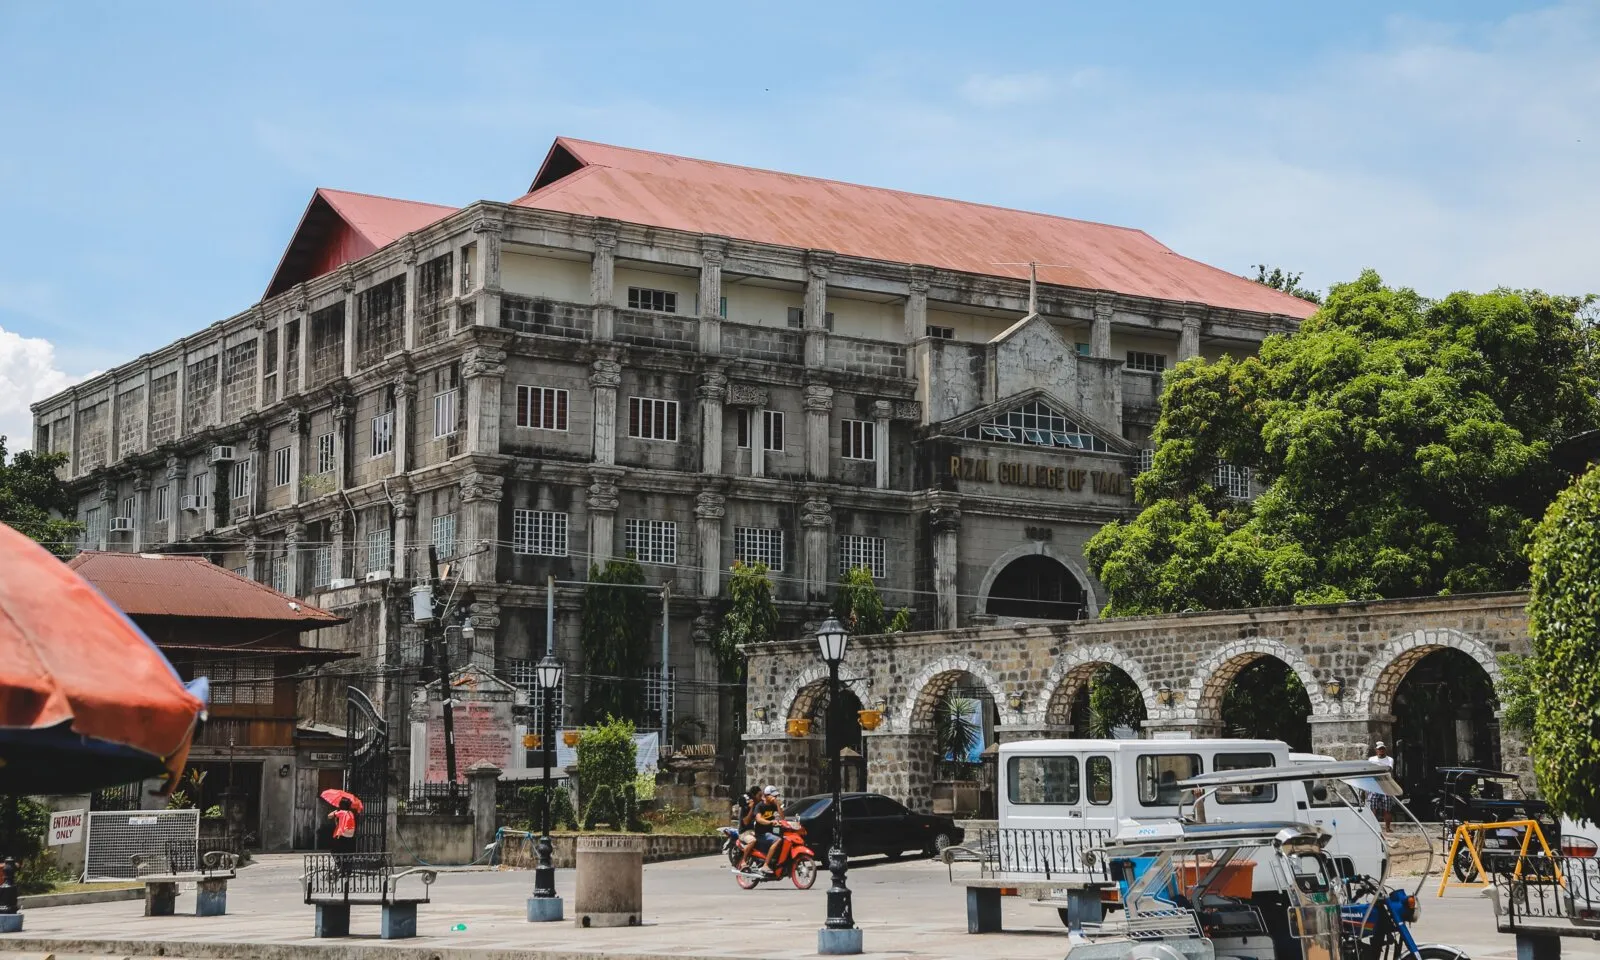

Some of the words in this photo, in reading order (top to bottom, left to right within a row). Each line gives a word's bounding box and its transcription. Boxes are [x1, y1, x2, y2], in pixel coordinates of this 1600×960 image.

[950, 455, 994, 483] RIZAL
[998, 461, 1065, 490] COLLEGE
[1067, 467, 1087, 492] OF
[1091, 470, 1128, 496] TAAL
[53, 814, 82, 829] ENTRANCE
[56, 829, 74, 840] ONLY
